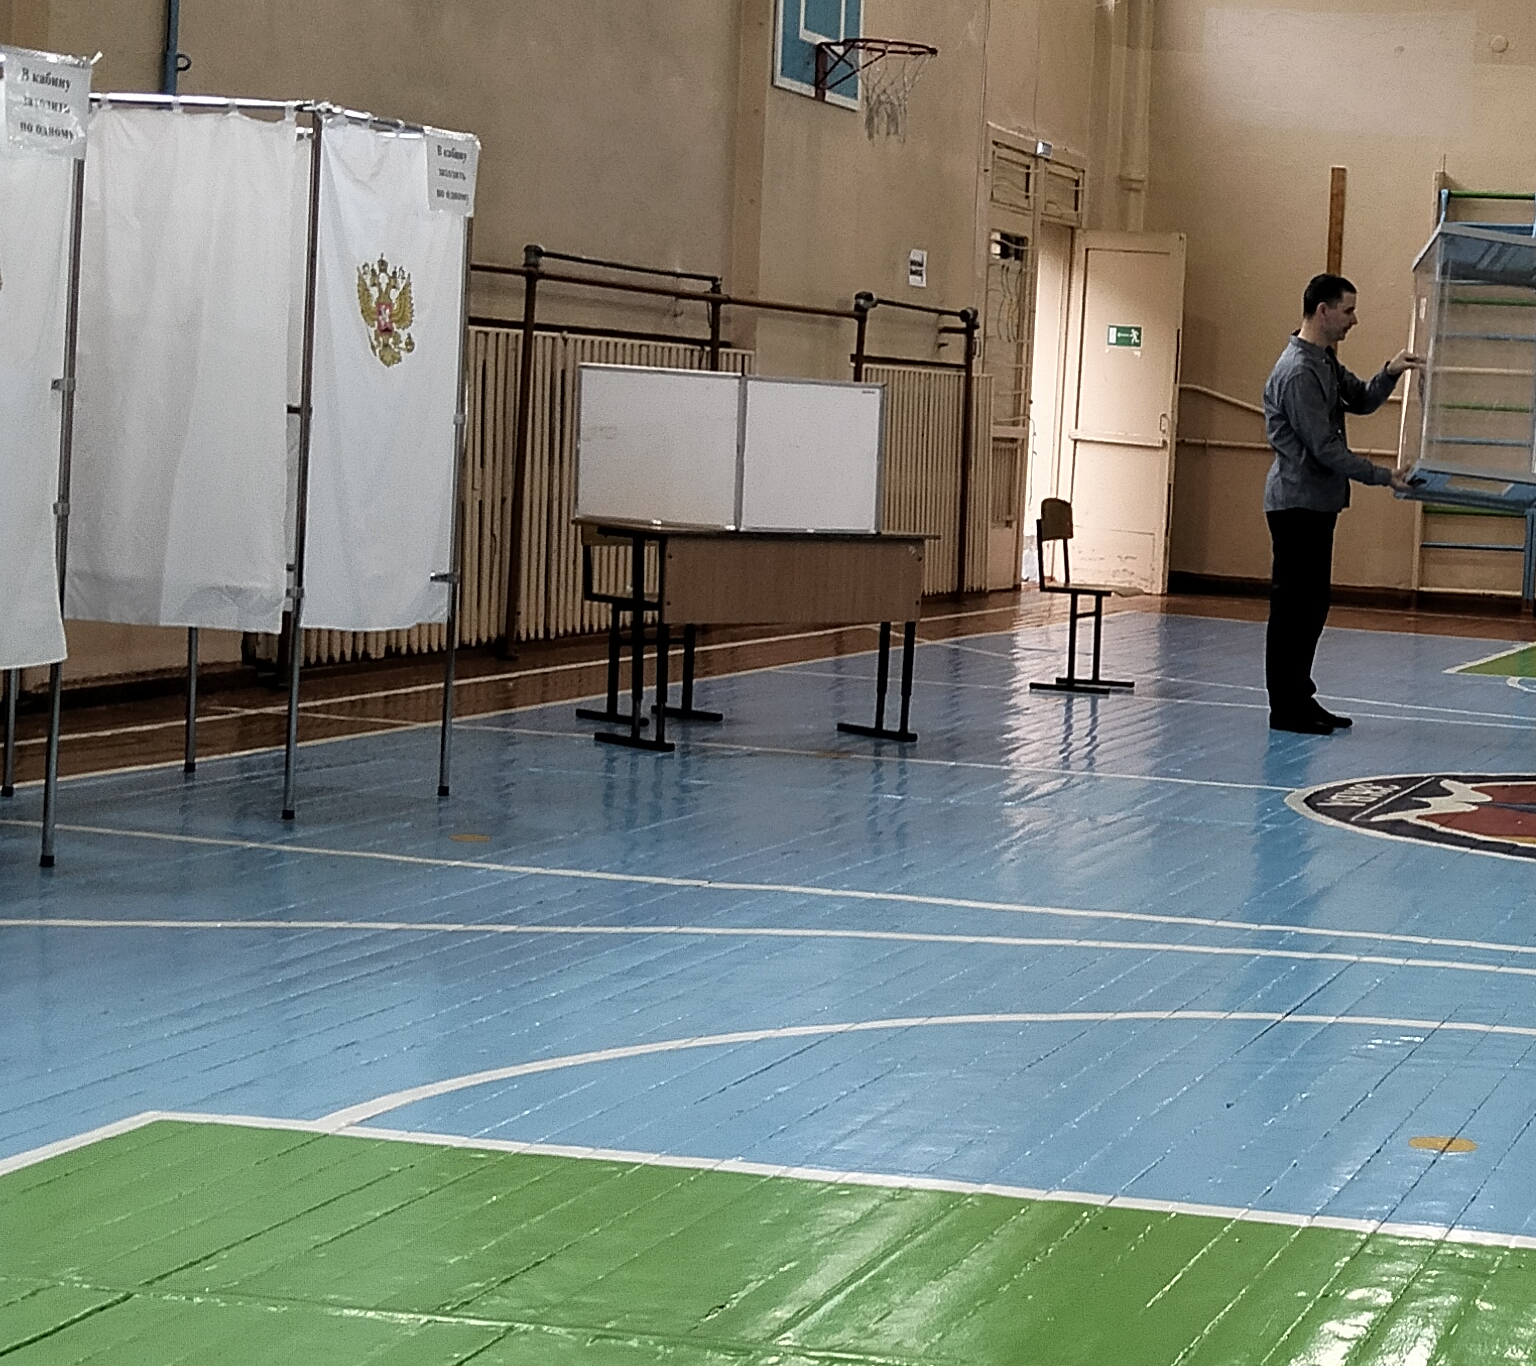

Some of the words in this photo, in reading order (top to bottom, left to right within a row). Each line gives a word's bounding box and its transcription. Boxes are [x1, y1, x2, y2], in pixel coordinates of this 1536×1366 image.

[21, 67, 29, 82] В
[32, 71, 72, 92] кабину
[20, 121, 33, 133] по
[36, 125, 74, 142] одному
